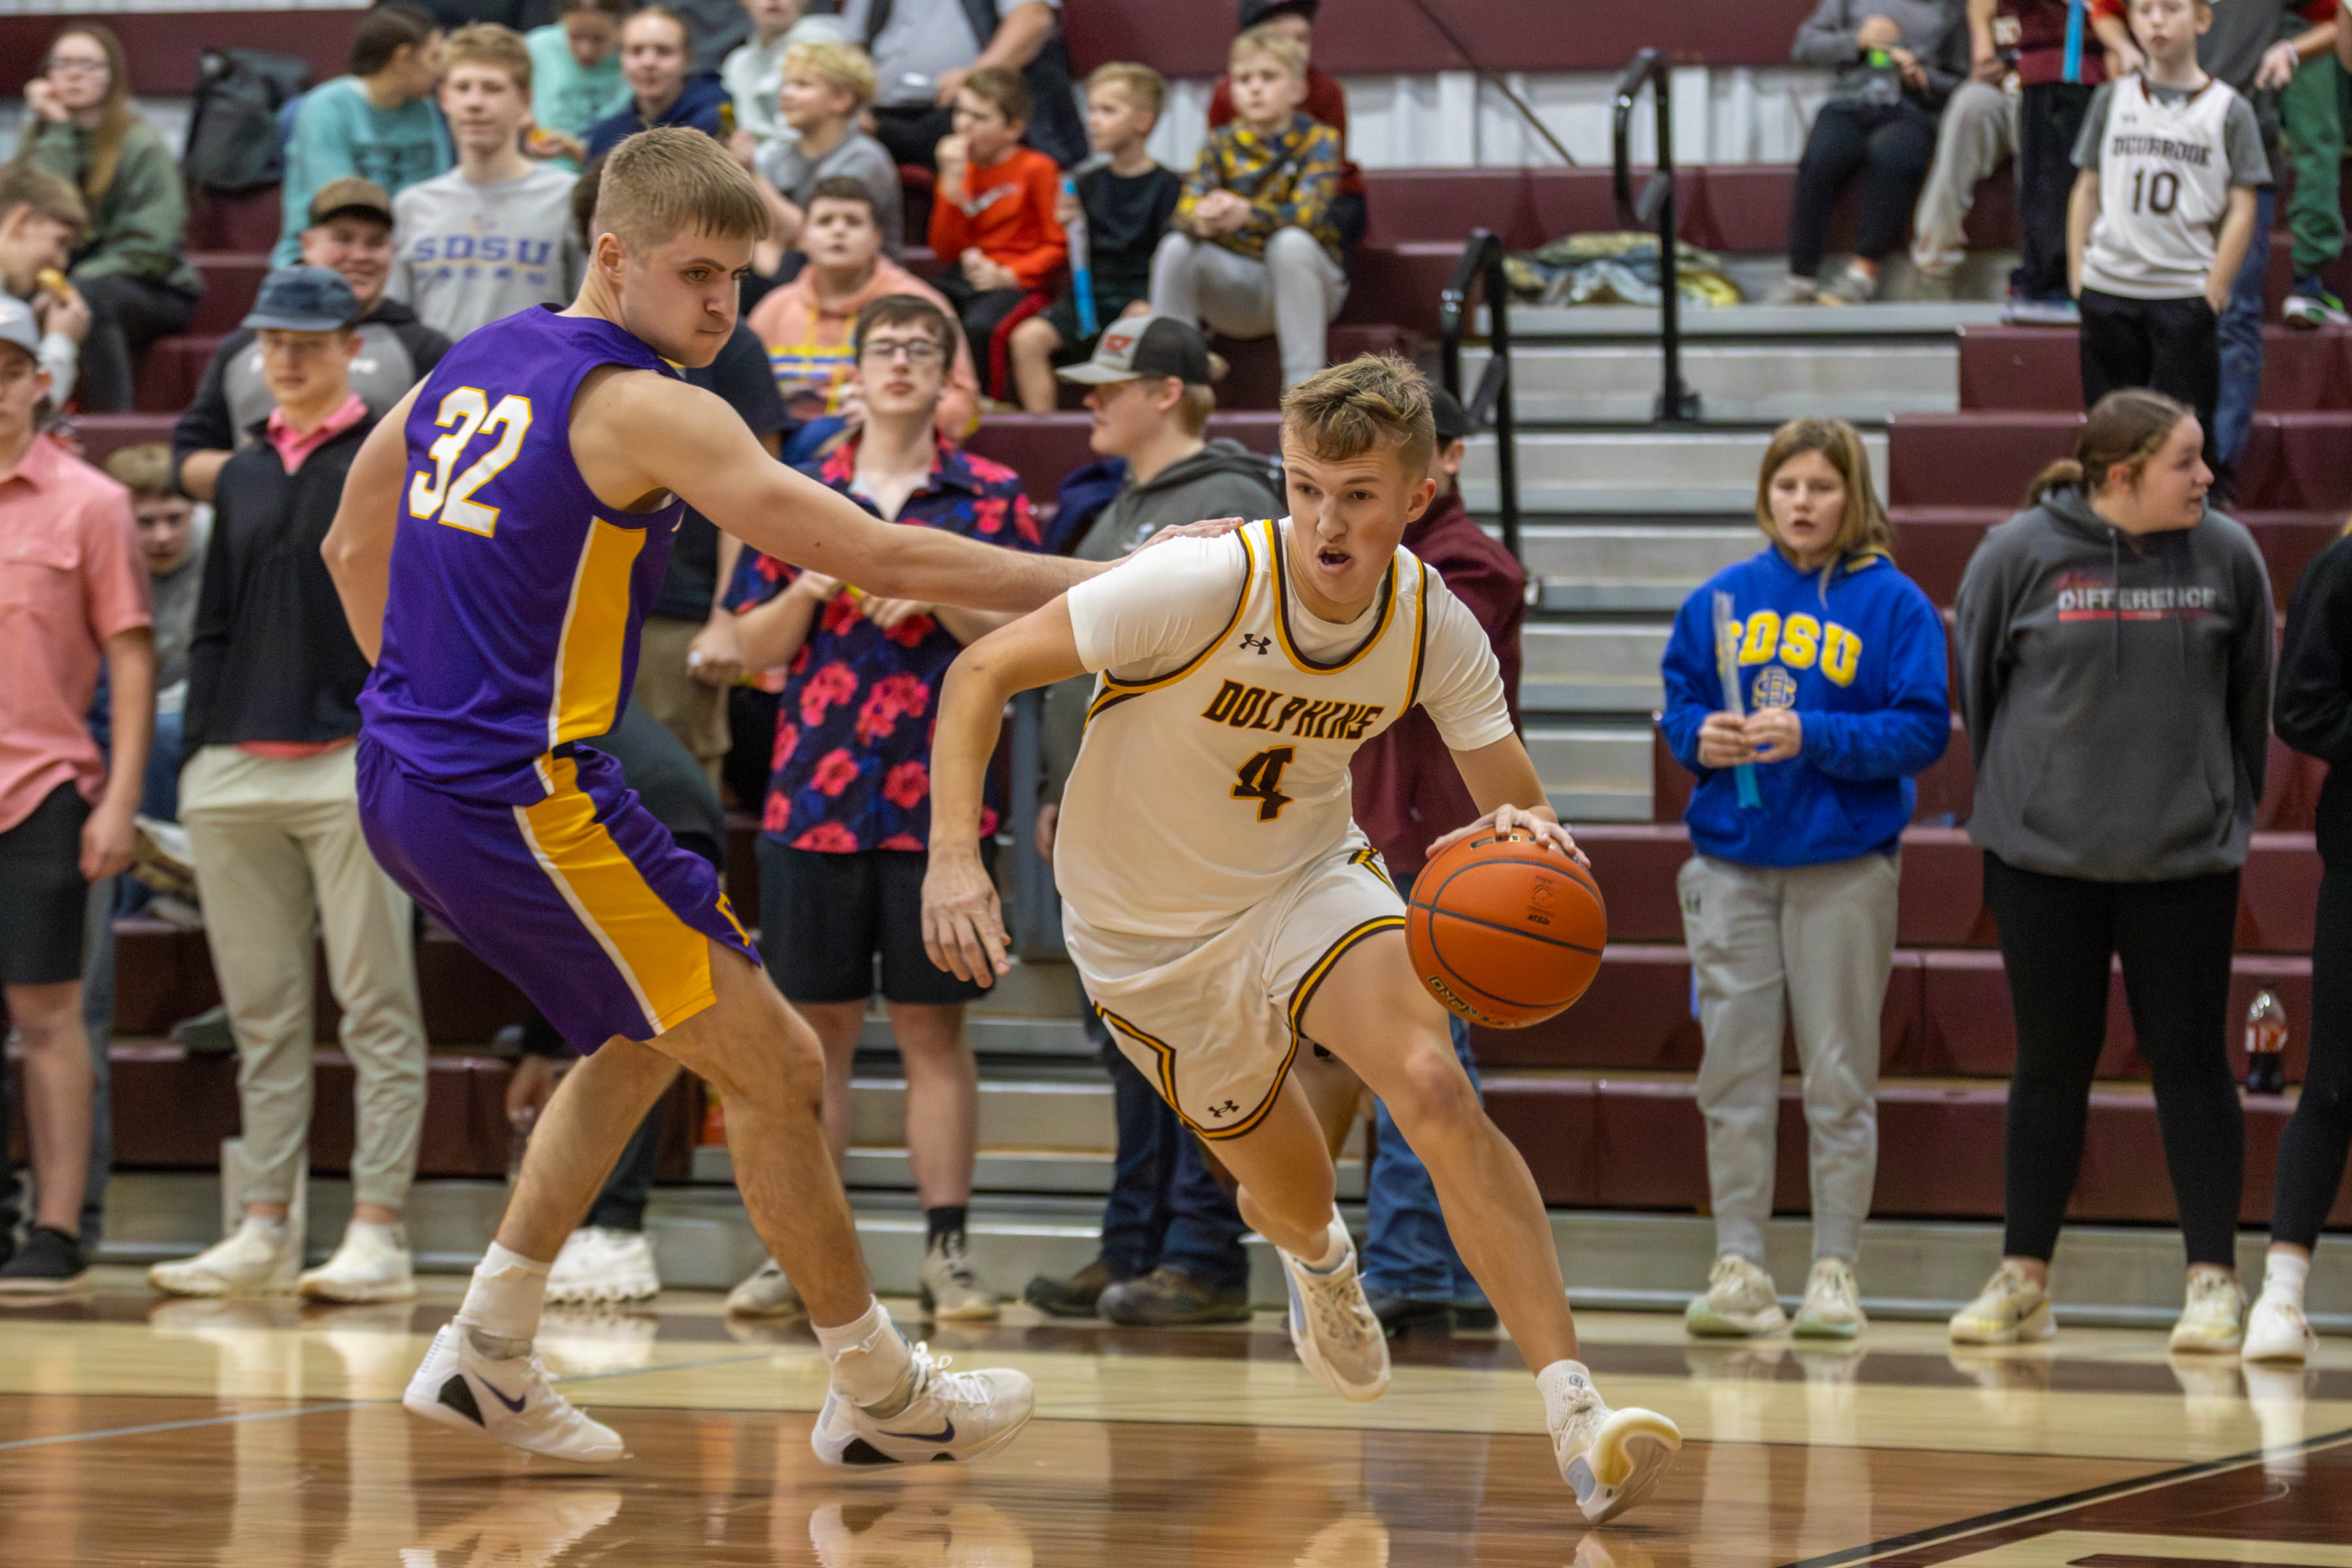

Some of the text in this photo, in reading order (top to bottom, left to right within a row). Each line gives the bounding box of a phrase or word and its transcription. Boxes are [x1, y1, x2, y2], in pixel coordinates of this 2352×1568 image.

[2134, 168, 2180, 214] 10
[414, 234, 551, 265] SDSU
[408, 385, 533, 538] 32
[1200, 678, 1386, 740] DOLPHINS
[1230, 745, 1296, 823] 4
